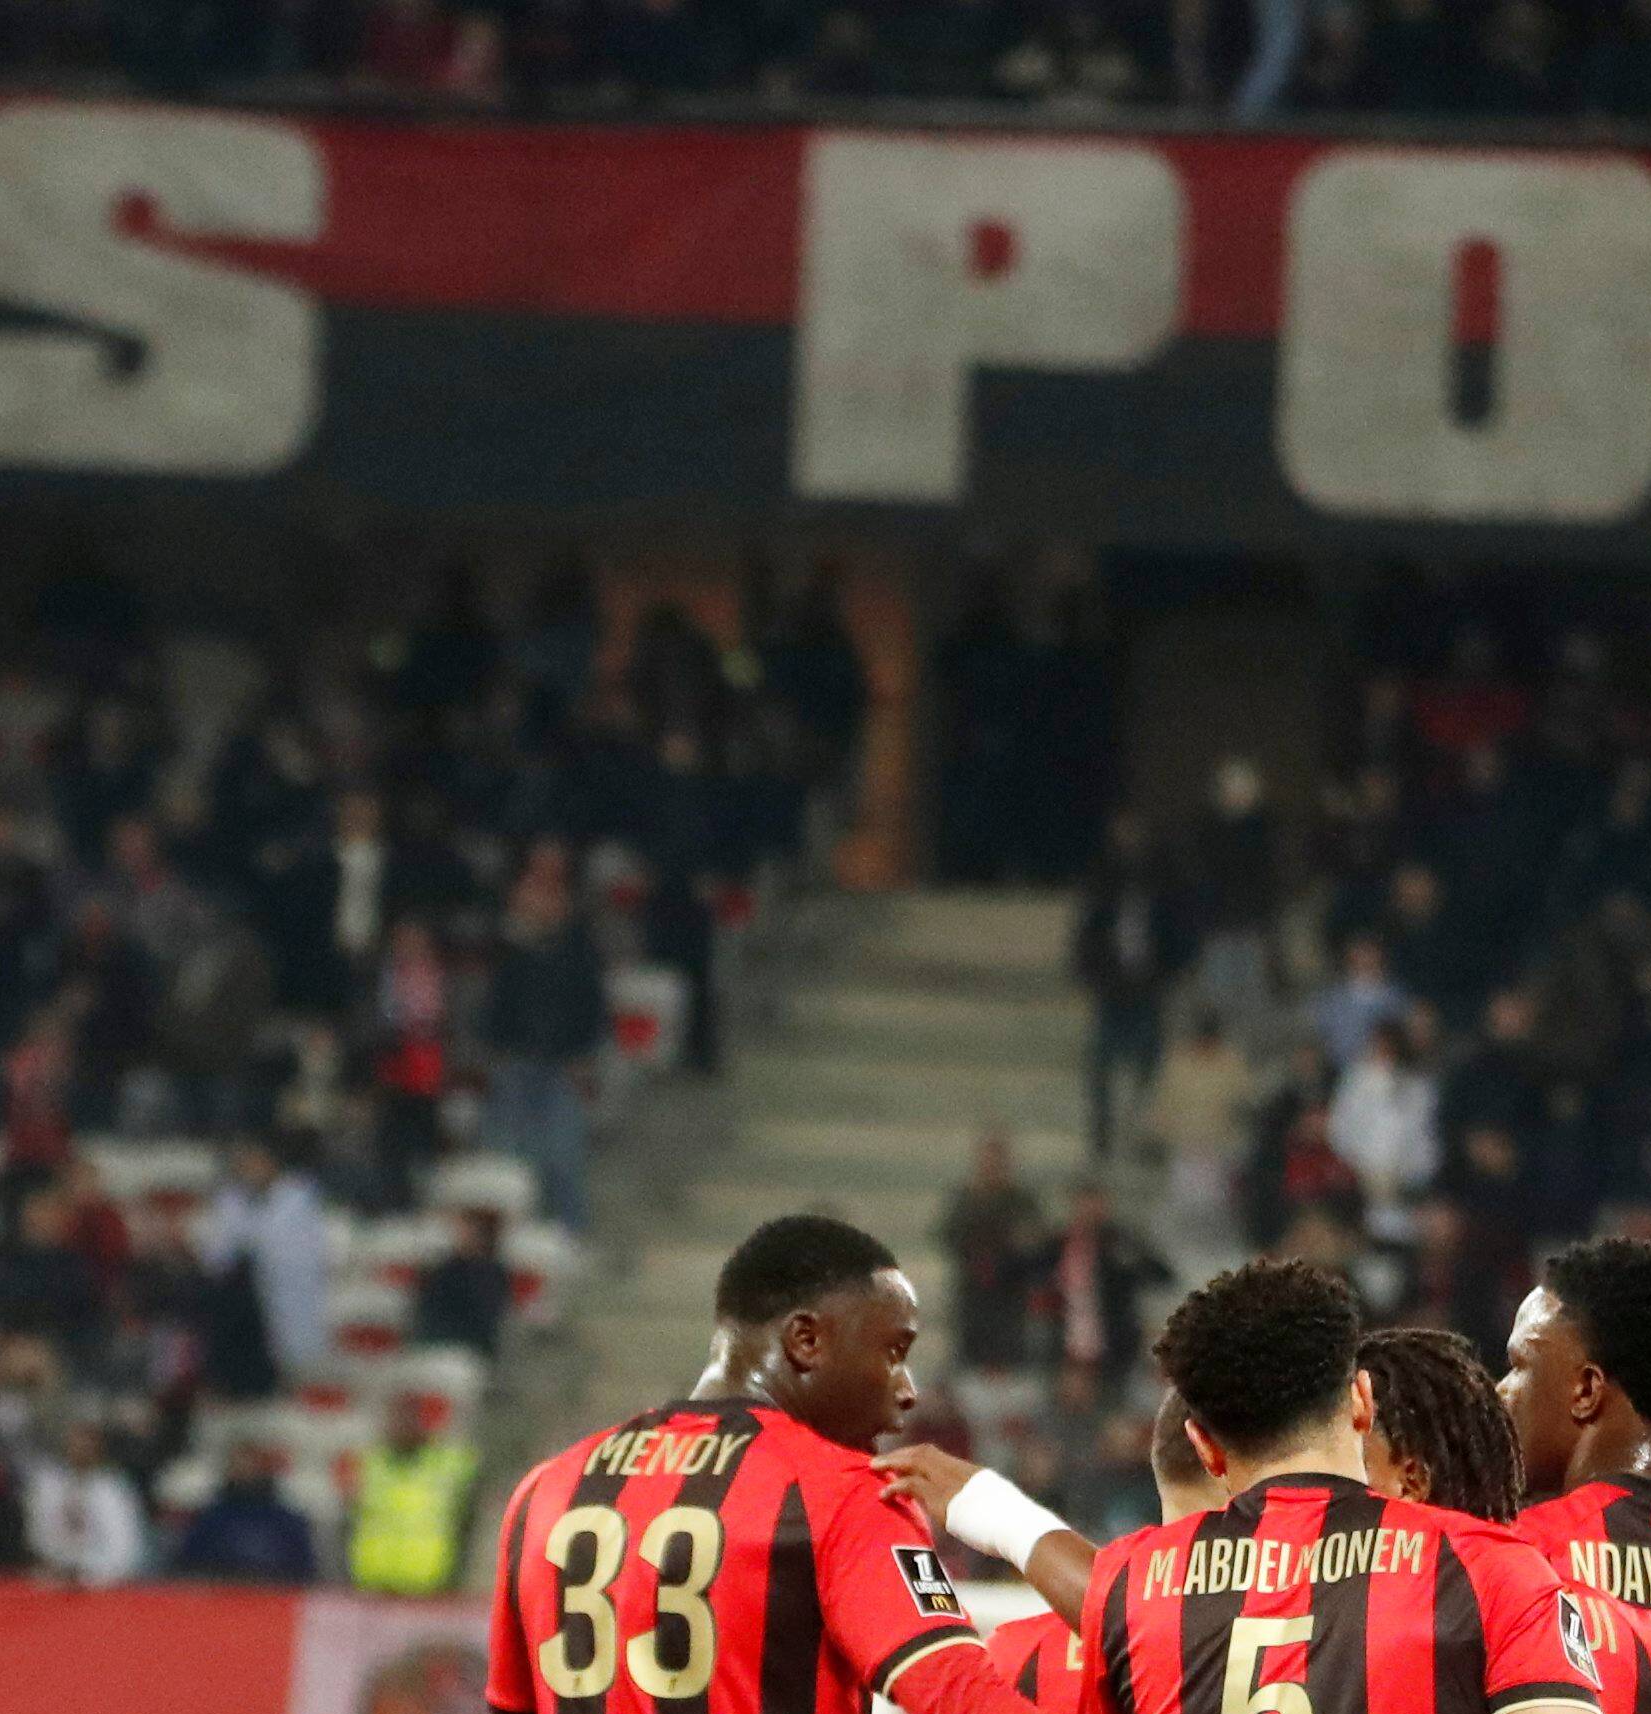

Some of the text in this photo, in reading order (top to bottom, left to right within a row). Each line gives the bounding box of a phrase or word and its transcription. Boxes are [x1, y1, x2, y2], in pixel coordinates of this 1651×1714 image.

[583, 1429, 752, 1477] MENDY
[1143, 1527, 1425, 1601] M.ABDELMONEM
[539, 1505, 723, 1699] 33
